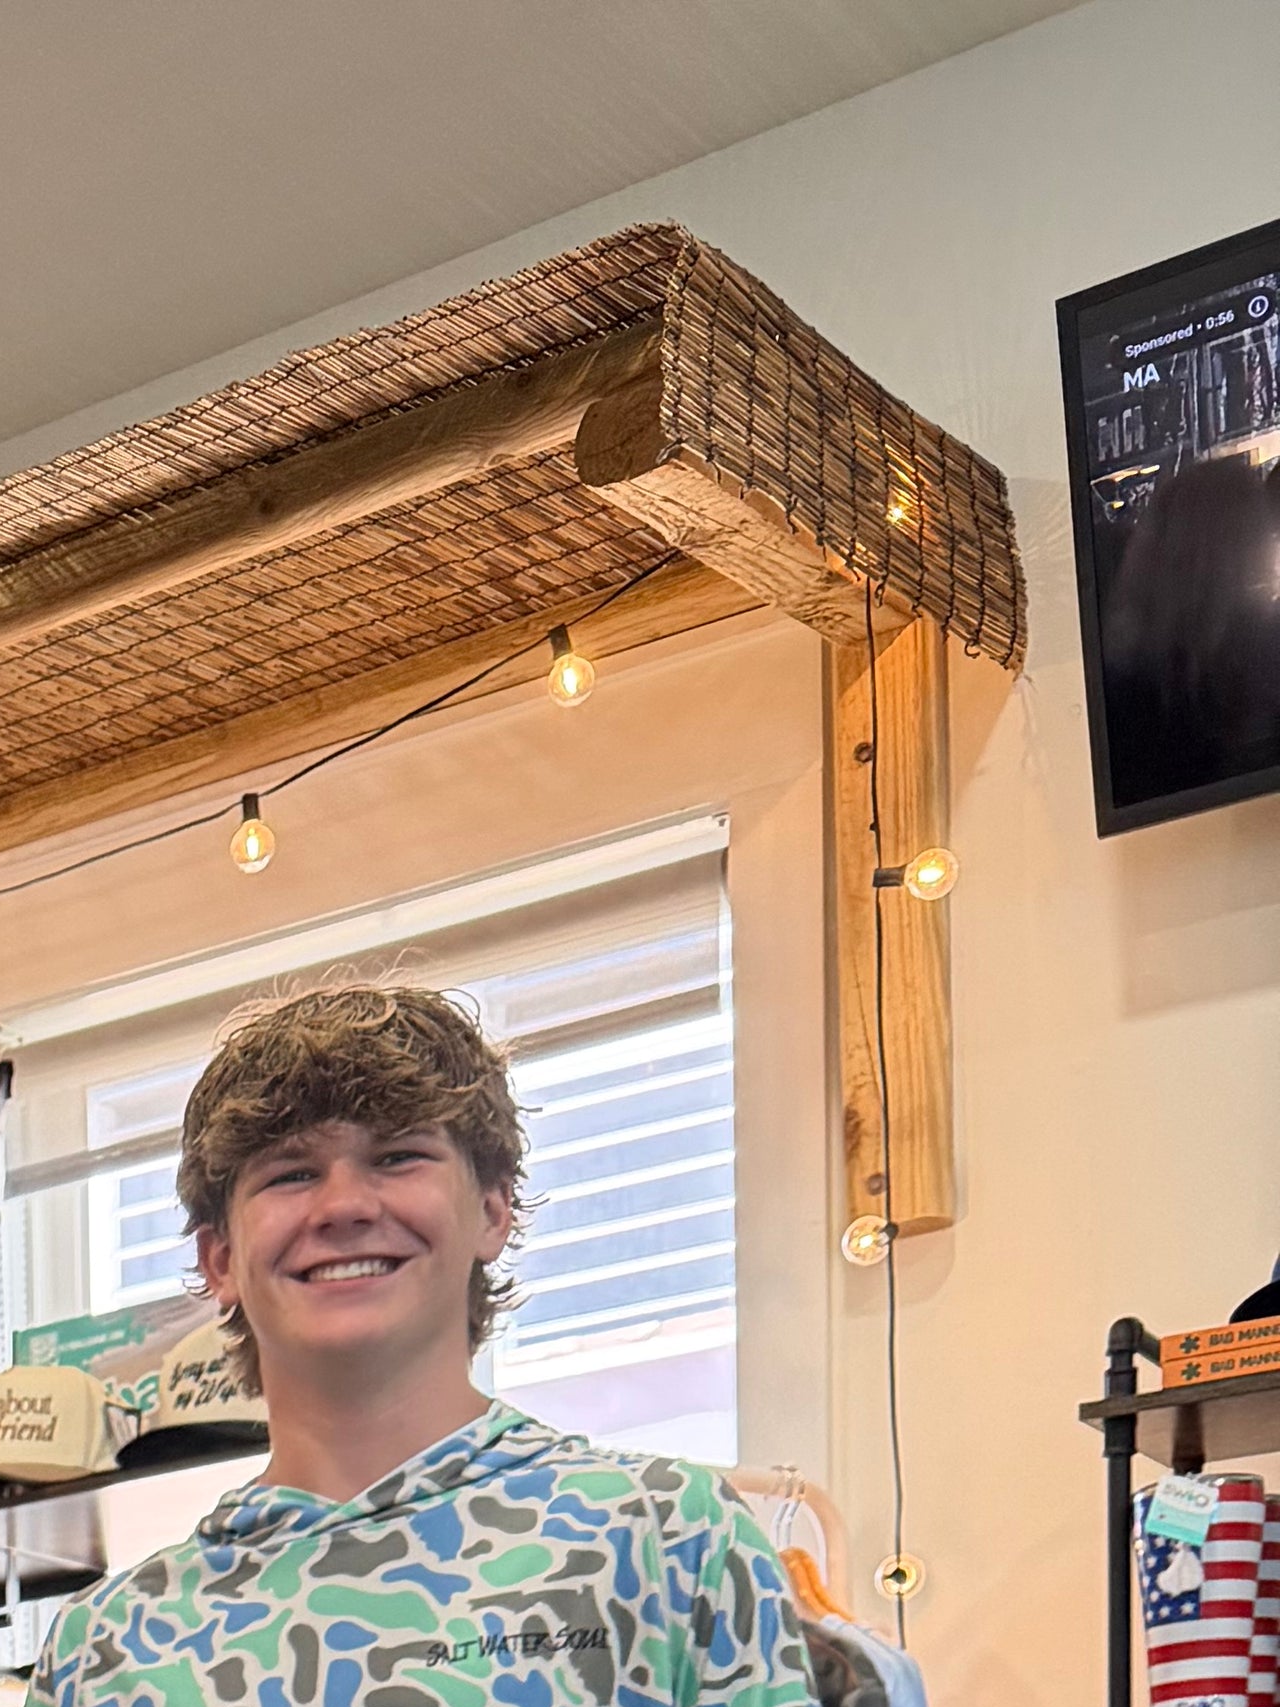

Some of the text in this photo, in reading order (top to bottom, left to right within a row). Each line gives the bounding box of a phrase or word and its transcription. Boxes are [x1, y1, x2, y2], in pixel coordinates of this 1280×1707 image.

[1124, 309, 1235, 358] Sponsored 0:56
[1123, 362, 1161, 393] MA
